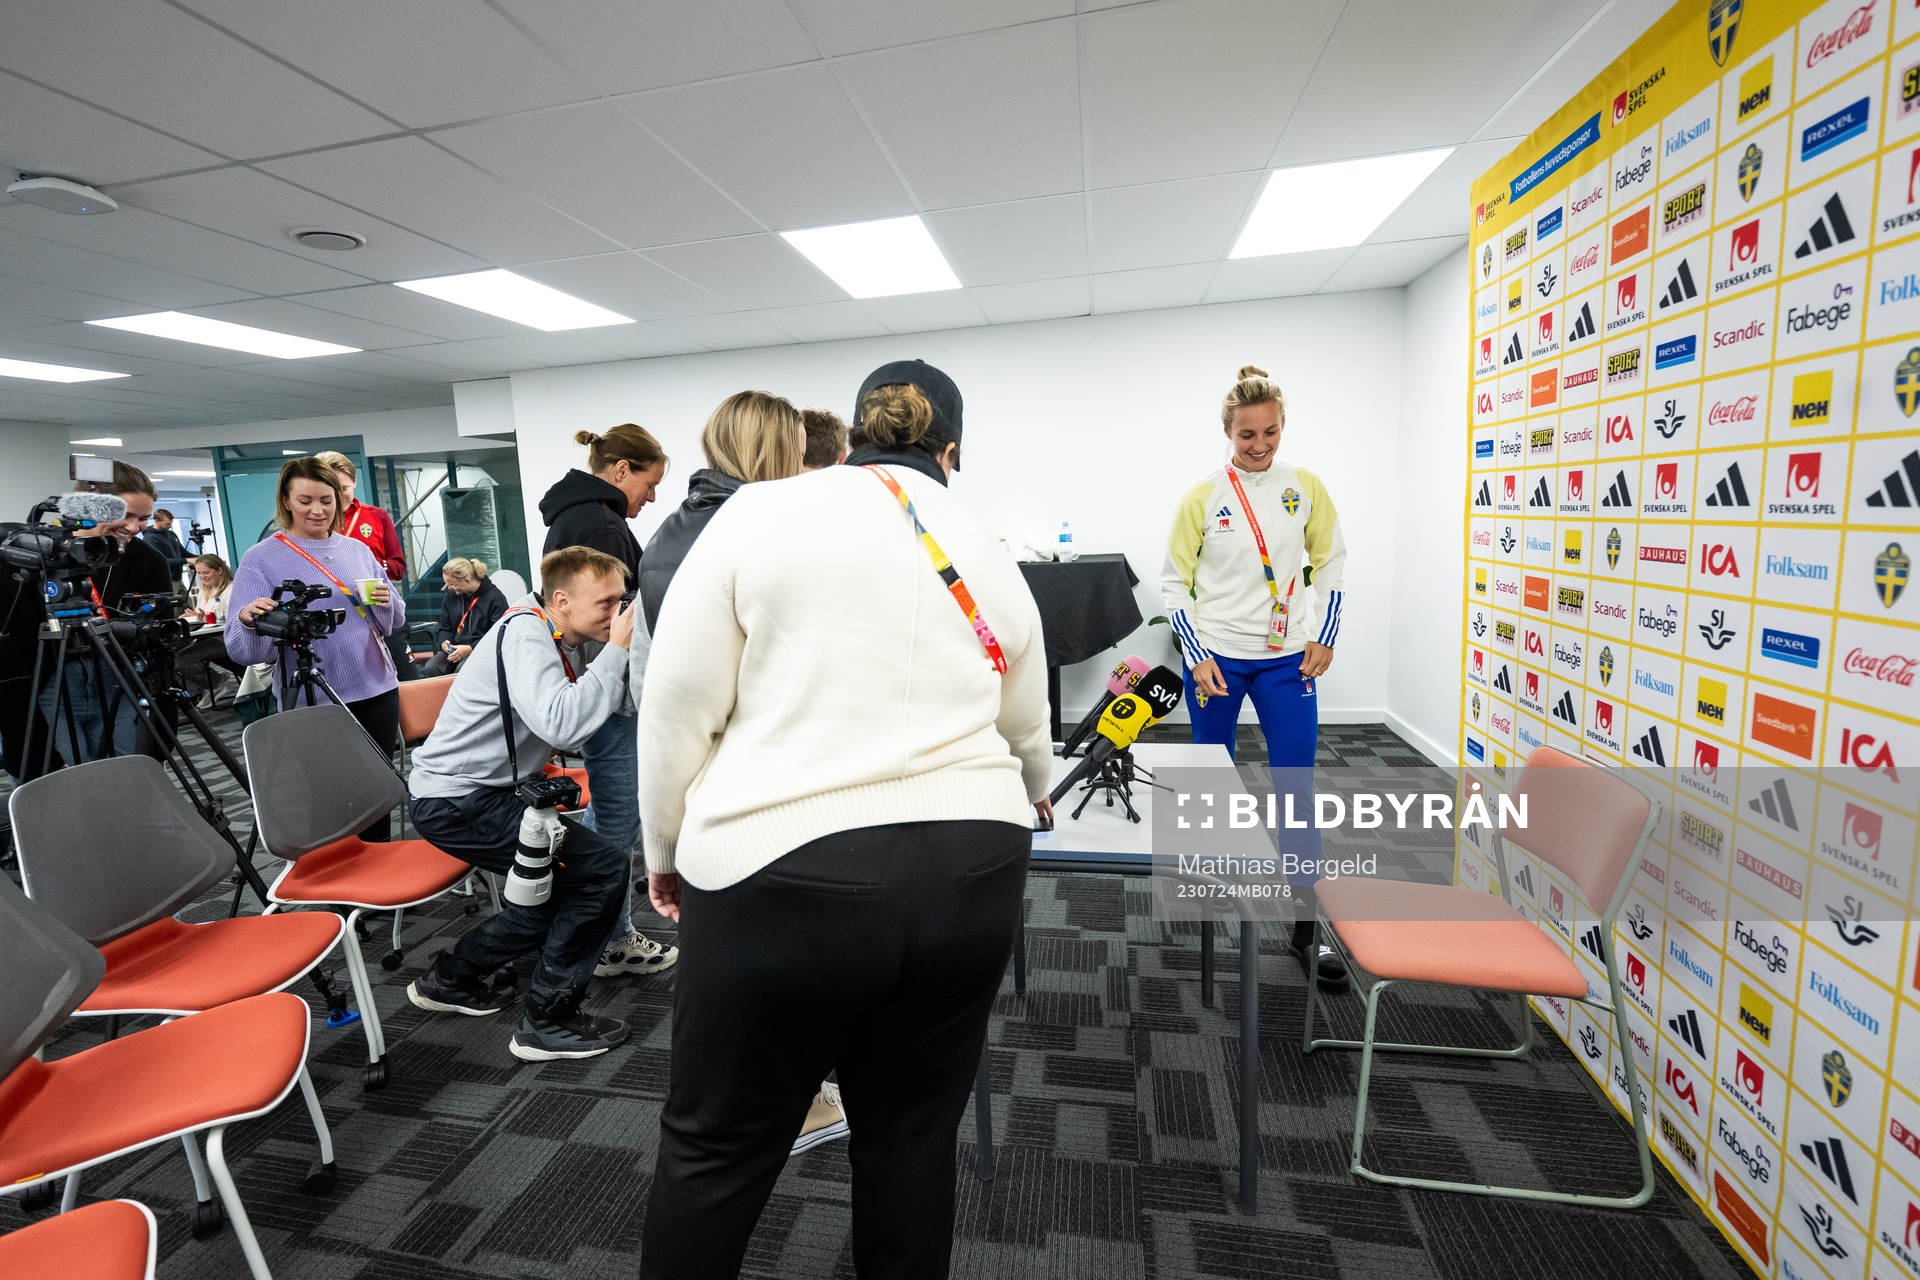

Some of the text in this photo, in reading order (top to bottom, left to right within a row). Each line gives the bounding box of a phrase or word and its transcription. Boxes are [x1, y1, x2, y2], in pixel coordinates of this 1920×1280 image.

[1628, 67, 1666, 103] SVENSKA
[1628, 96, 1647, 116] SPEL
[1665, 117, 1711, 157] Folksam
[1515, 128, 1592, 193] Fotbollens huvudsponsor
[1615, 159, 1652, 193] Fabege
[1486, 193, 1505, 212] SVENSKA
[1486, 209, 1495, 221] SPEL
[1571, 187, 1603, 216] Scandic
[1664, 183, 1706, 228] SPORT
[1665, 201, 1705, 234] BLADET
[1506, 228, 1527, 255] SPORT
[1543, 264, 1551, 279] SJ
[1715, 263, 1773, 292] SVENSKA SPEL
[1607, 311, 1646, 331] SVENSKA SPEL
[1787, 302, 1851, 334] Fabege
[1713, 320, 1766, 349] Scandic
[1531, 342, 1559, 358] SVENSKA SPEL
[1607, 349, 1641, 378] SPORT
[1564, 369, 1598, 388] BAUHAUS
[1608, 370, 1638, 383] BLADET
[1477, 393, 1493, 415] ICA
[1501, 388, 1524, 404] Scandic
[1664, 399, 1676, 417] SJ
[1531, 428, 1554, 448] SPORT
[1564, 427, 1592, 444] Scandic
[1606, 415, 1633, 444] ICA
[1501, 441, 1522, 457] Fabege
[1644, 505, 1687, 513] SVENSKA SPEL
[1769, 504, 1836, 515] SVENSKA SPEL
[1505, 526, 1511, 538] SJ
[1527, 536, 1550, 551] Folksam
[1640, 548, 1686, 563] BAUHAUS
[1700, 544, 1740, 578] ICA
[1766, 554, 1828, 581] Folksam
[1495, 579, 1518, 596] Scandic
[1558, 587, 1584, 608] SPORT
[1477, 612, 1482, 625] SJ
[1594, 600, 1627, 620] Scandic
[1639, 608, 1677, 638] Fabege
[1711, 609, 1724, 629] SJ
[1496, 621, 1516, 638] SPORT
[1525, 630, 1544, 657] ICA
[1554, 643, 1581, 670] Fabege
[1149, 684, 1178, 709] svt
[1635, 670, 1674, 697] Folksam
[1519, 697, 1545, 714] SVENSKA SPEL
[1756, 713, 1796, 734] Swedbank
[1586, 729, 1621, 752] SVENSKA SPEL
[1840, 728, 1900, 784] ICA
[1680, 774, 1730, 805] SVENSKA SPEL
[1681, 811, 1723, 849] SPORT
[1737, 852, 1801, 897] BAUHAUS
[1821, 842, 1900, 890] SVENSKA SPEL
[1634, 904, 1645, 923] SJ
[1673, 880, 1719, 922] Scandic
[1844, 895, 1863, 923] SJ
[1560, 924, 1570, 938] SPEL
[1734, 921, 1787, 974] Fabege
[1669, 939, 1714, 988] Folksam
[1619, 980, 1640, 1004] VENSKA
[1640, 997, 1654, 1018] SPEL
[1809, 970, 1879, 1036] Folksam
[1586, 1025, 1595, 1043] SJ
[1665, 1058, 1699, 1116] ICA
[1721, 1077, 1777, 1136] SVENSKA SPEL
[1719, 1117, 1769, 1184] Fabege
[1815, 1203, 1832, 1234] SJ
